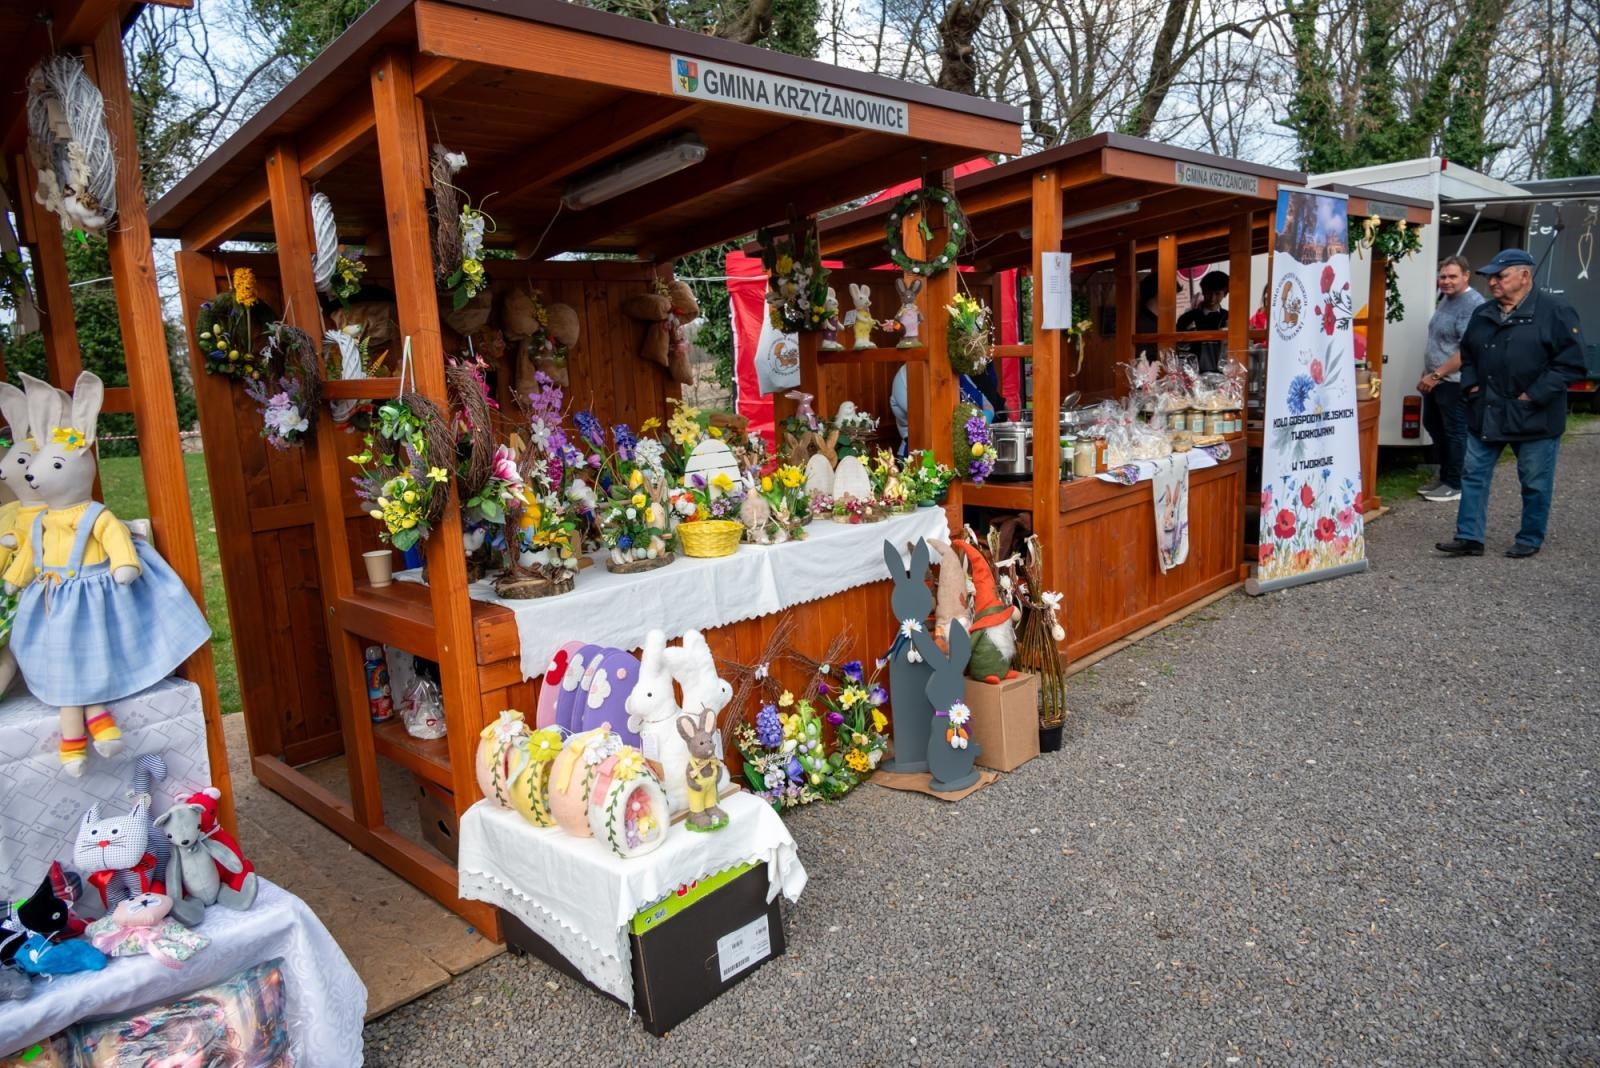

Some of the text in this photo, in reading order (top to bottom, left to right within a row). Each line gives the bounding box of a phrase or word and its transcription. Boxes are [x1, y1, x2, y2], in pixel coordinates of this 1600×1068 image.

[704, 69, 904, 129] GMINA KRZYŻANOWICE
[1185, 168, 1207, 184] GMINA
[1291, 462, 1298, 472] W
